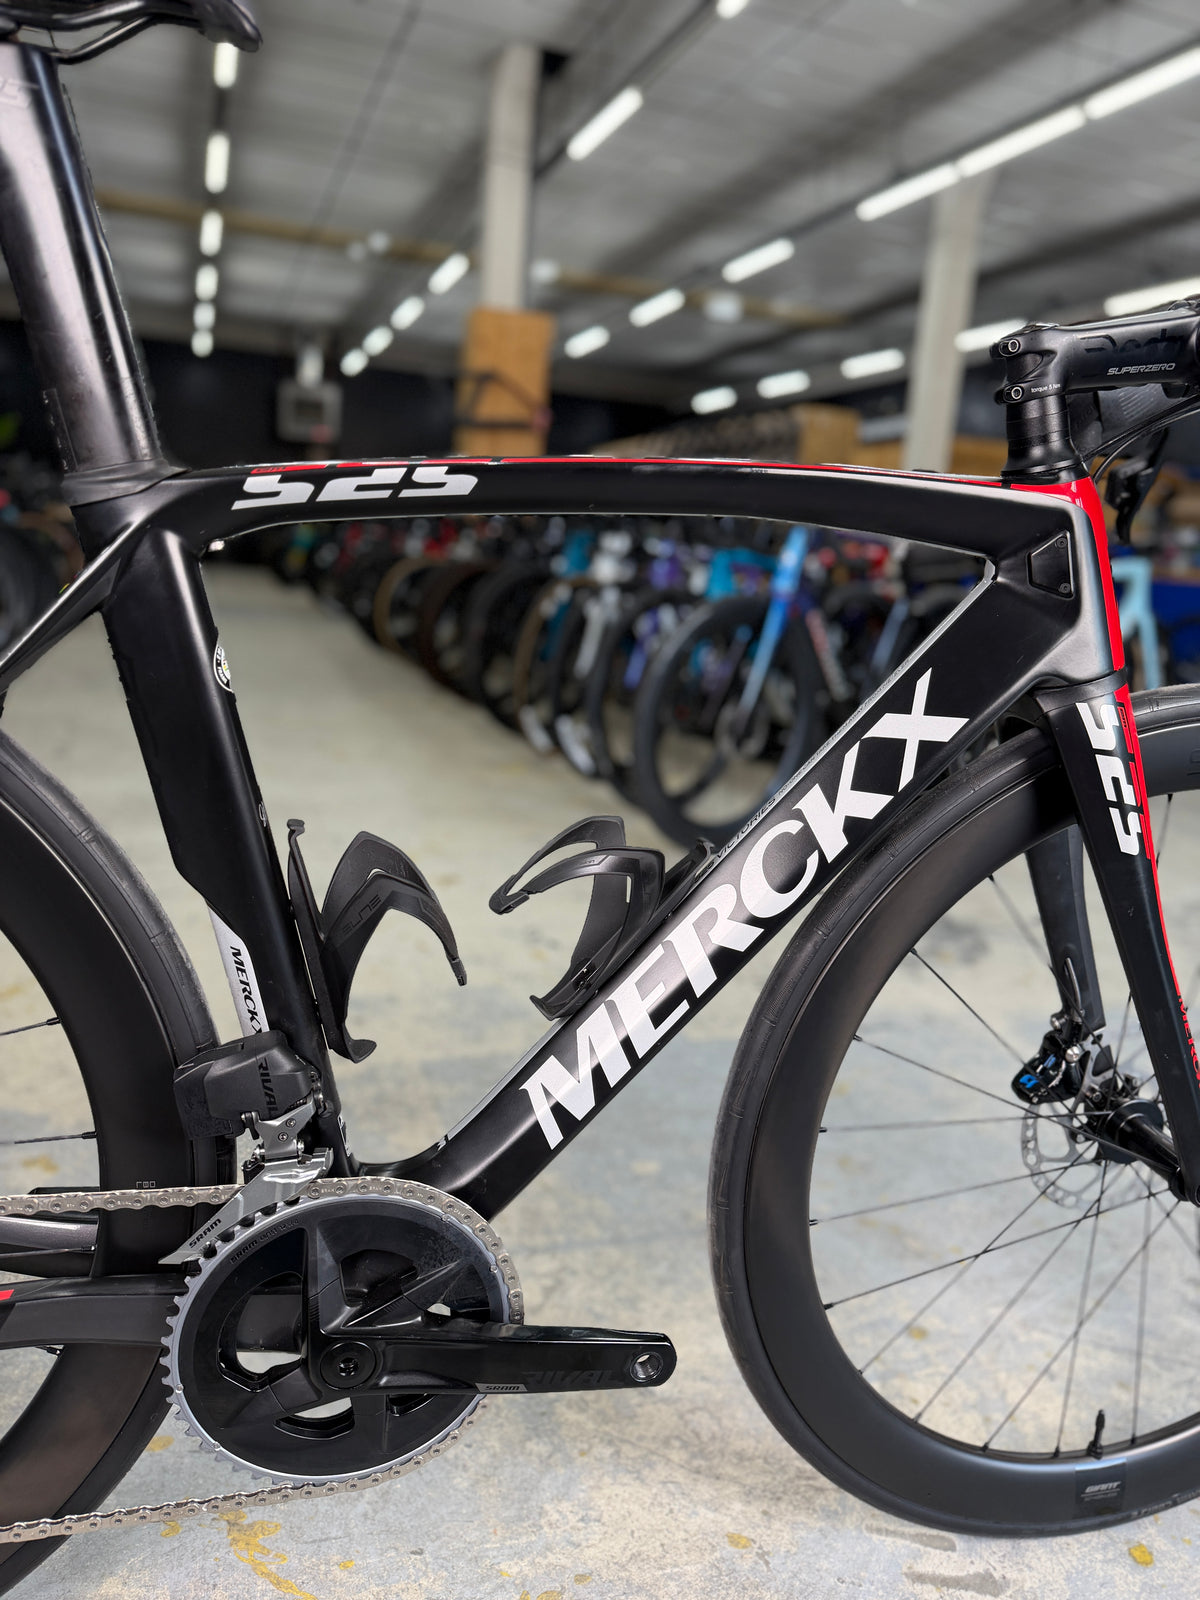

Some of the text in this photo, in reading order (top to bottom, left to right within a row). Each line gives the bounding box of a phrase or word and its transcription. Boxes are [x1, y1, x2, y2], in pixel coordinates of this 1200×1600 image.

[1107, 363, 1176, 376] SUPERZERO
[519, 667, 970, 1149] MERCKX
[258, 1057, 279, 1120] RIVAL
[188, 1218, 222, 1249] SRAM
[521, 1370, 625, 1387] RIVAL
[1085, 1482, 1121, 1492] GIANT
